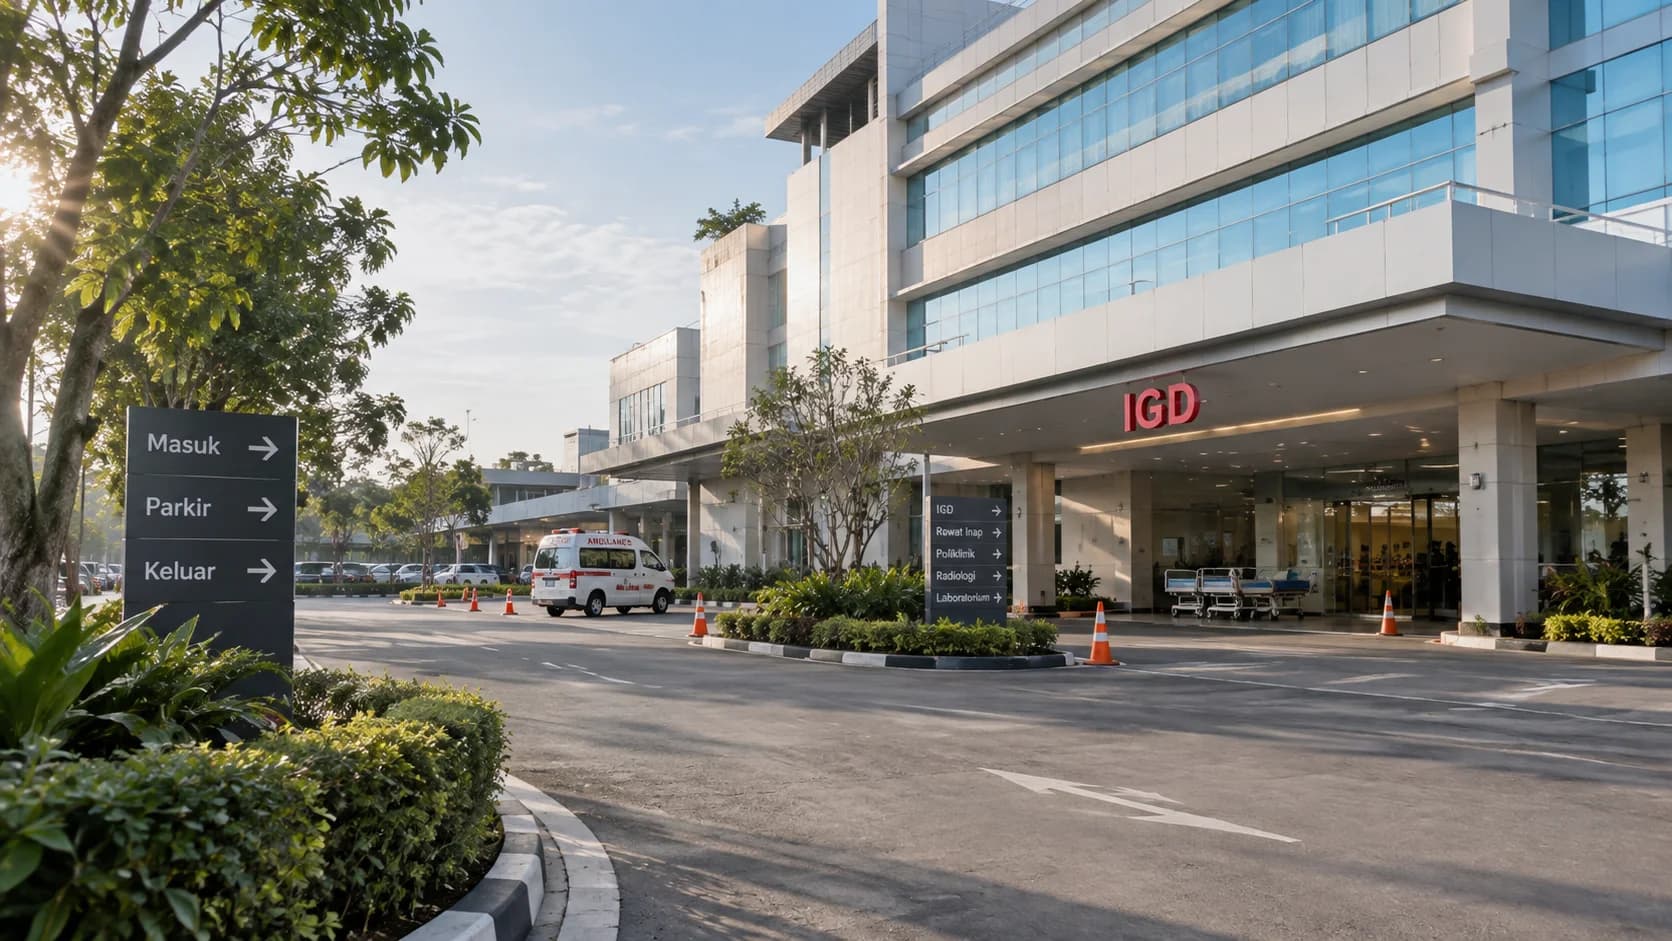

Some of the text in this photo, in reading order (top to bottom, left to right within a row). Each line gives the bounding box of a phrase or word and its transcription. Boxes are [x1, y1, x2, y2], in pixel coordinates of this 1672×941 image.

[1123, 382, 1201, 433] IGD
[147, 432, 221, 455] Masuk
[145, 496, 211, 517] Parkir
[144, 560, 217, 581] Keluar
[936, 570, 976, 584] Radiologi
